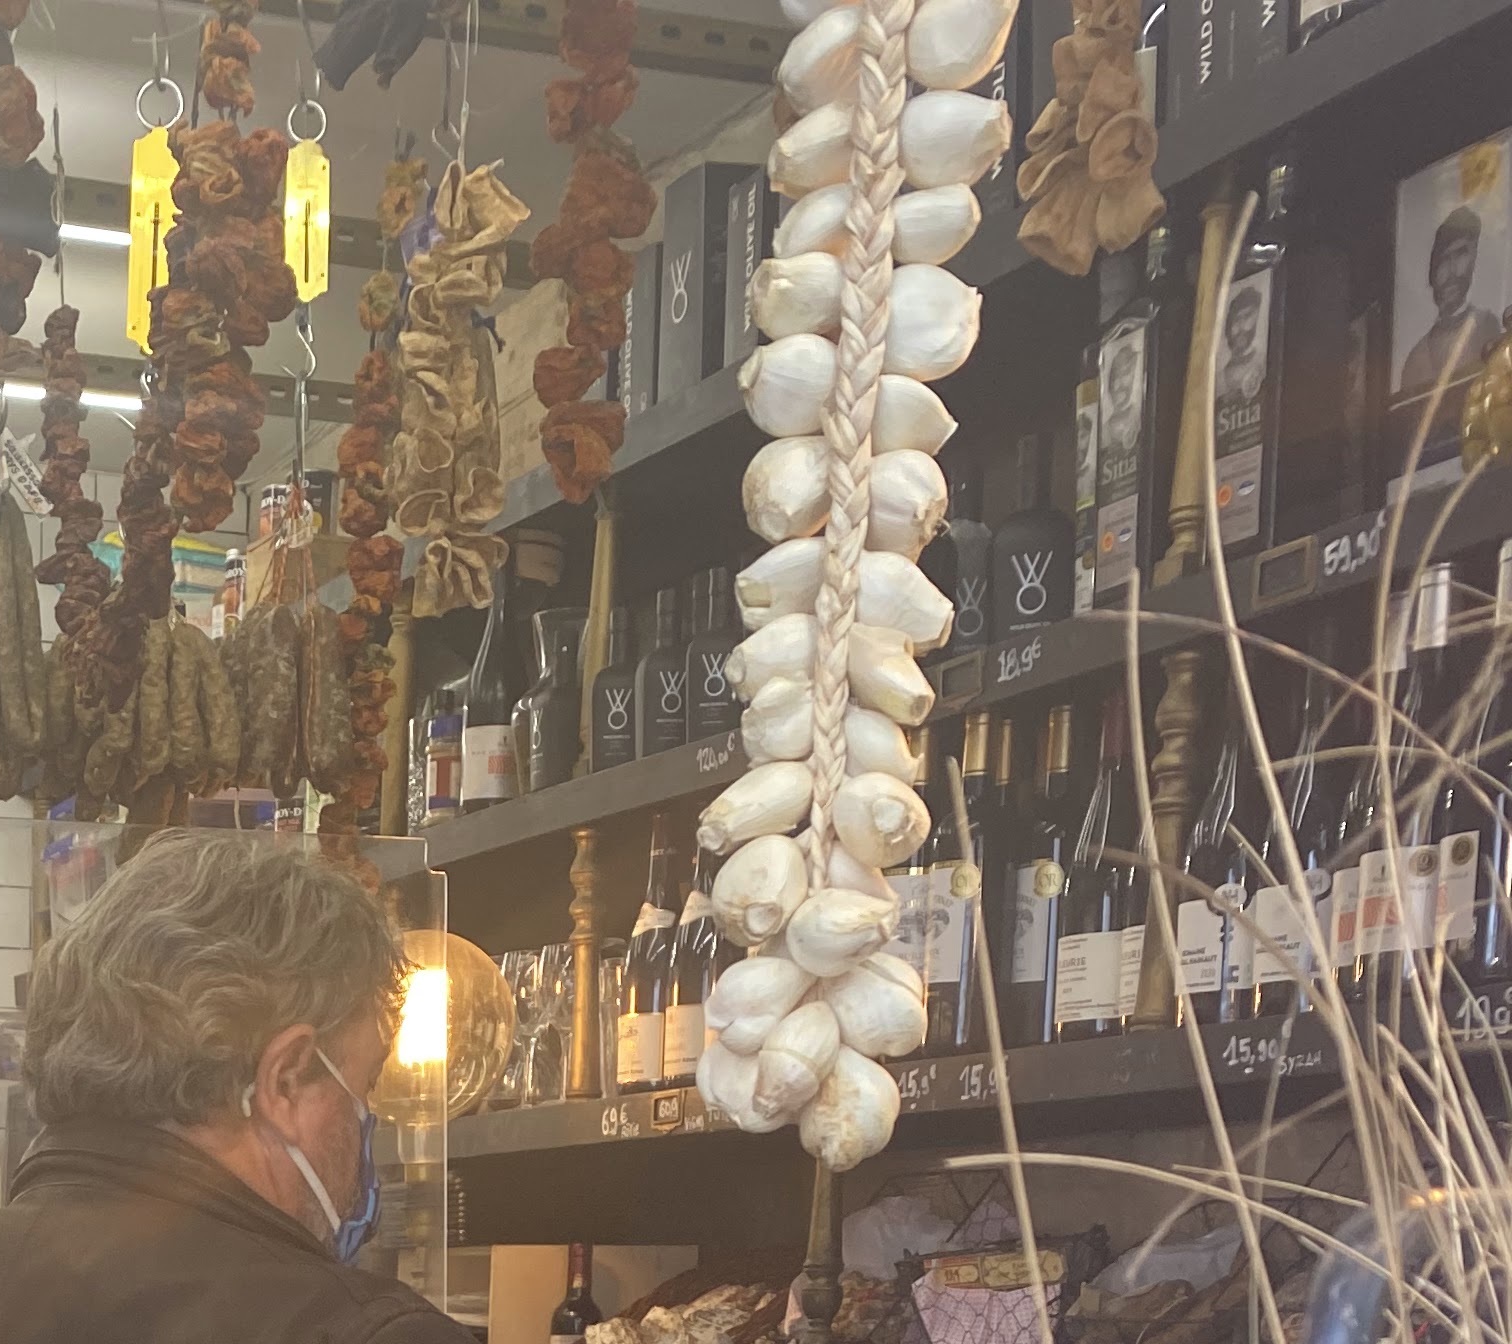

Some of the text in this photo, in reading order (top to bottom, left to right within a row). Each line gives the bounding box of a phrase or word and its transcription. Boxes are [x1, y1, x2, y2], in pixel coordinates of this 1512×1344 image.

[1199, 20, 1214, 85] WILD
[746, 181, 757, 216] OIL
[744, 225, 757, 277] OLIVE
[622, 338, 633, 391] OLIVE
[1217, 401, 1262, 436] Sitia
[1101, 454, 1138, 486] Sitia
